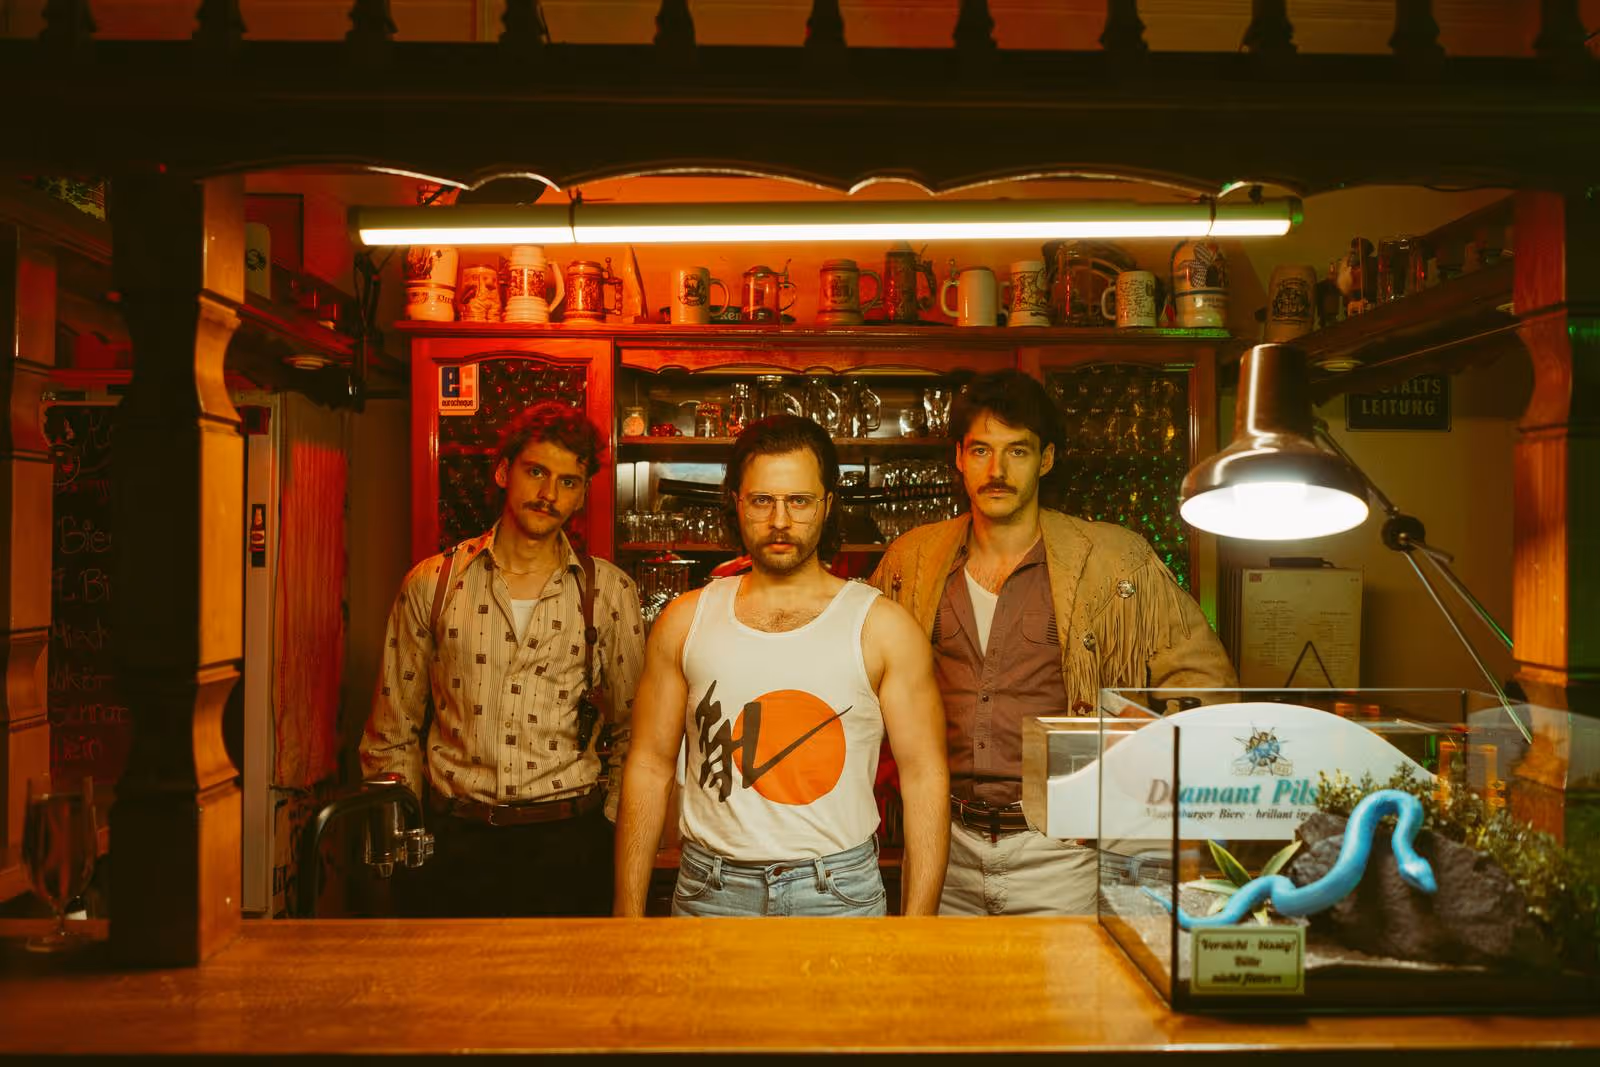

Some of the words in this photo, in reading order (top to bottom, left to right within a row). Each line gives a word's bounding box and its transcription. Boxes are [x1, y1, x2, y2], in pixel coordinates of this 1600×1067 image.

[442, 399, 473, 408] eurocheque
[1361, 399, 1436, 415] LEITUNG
[1145, 779, 1261, 804] Damant
[1219, 807, 1245, 819] Biere
[1255, 807, 1293, 819] brillant
